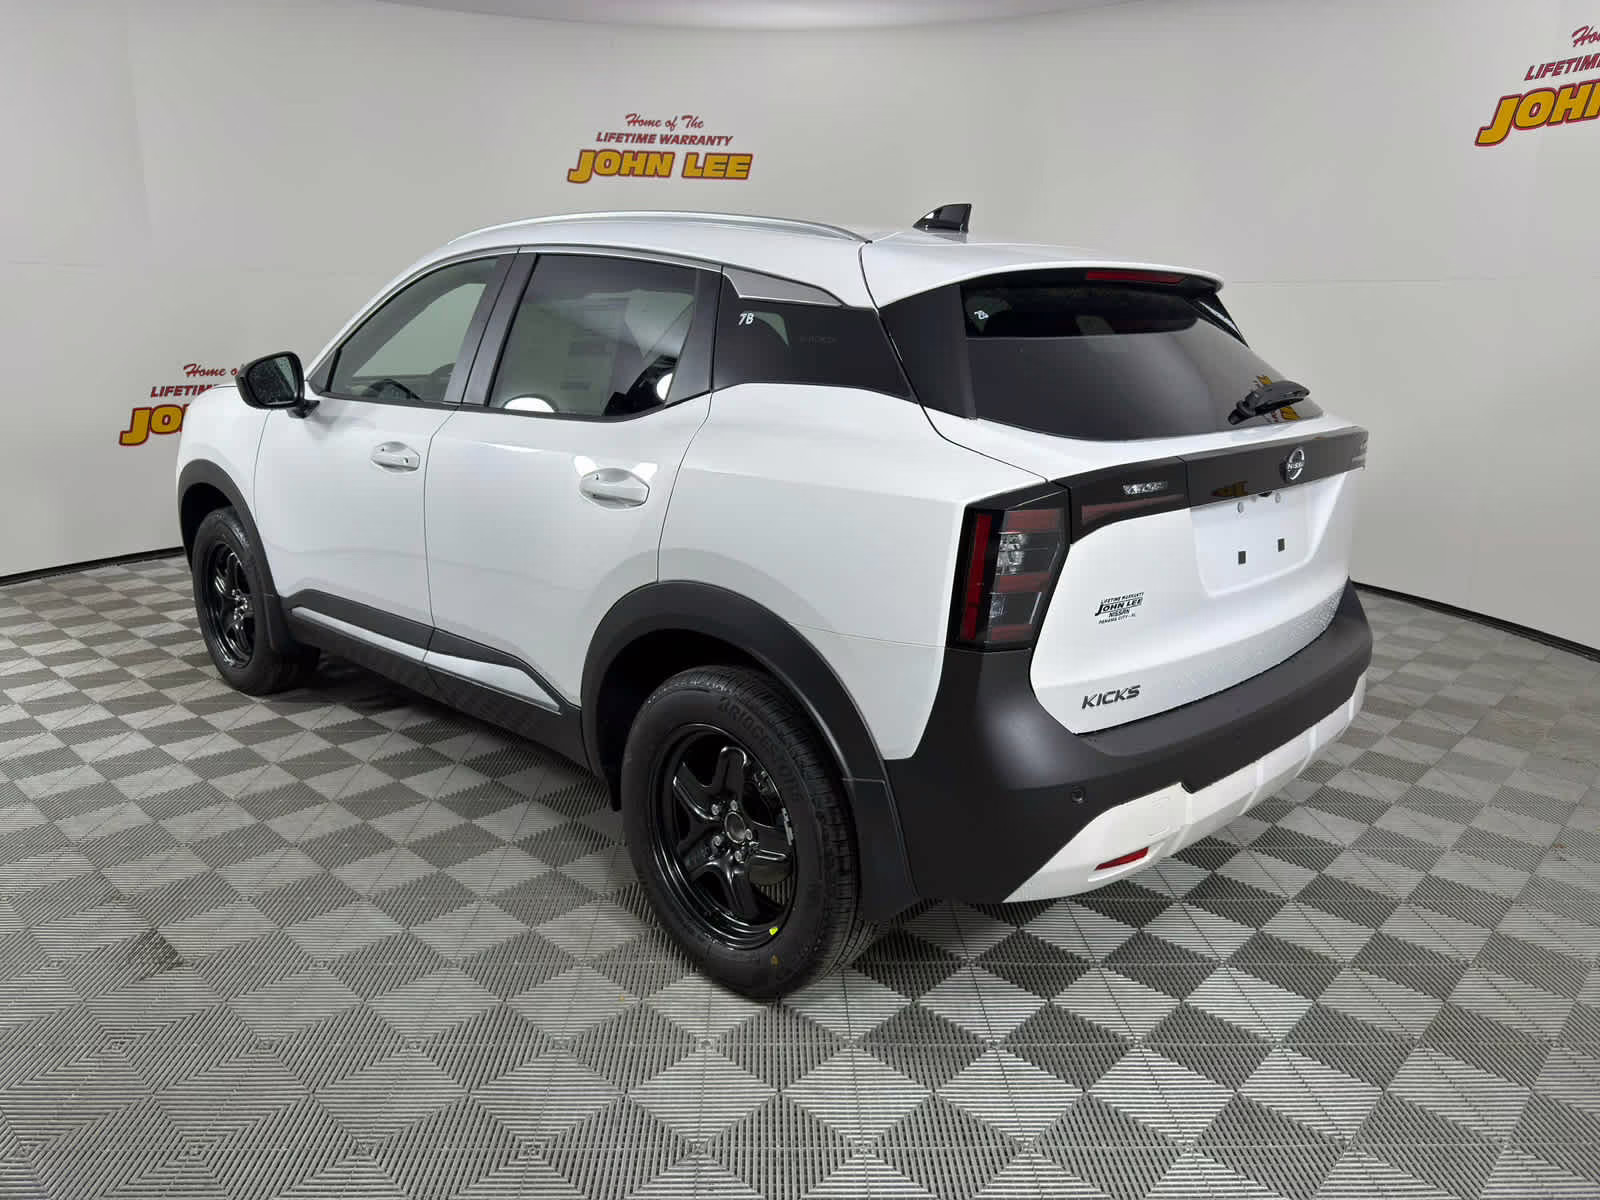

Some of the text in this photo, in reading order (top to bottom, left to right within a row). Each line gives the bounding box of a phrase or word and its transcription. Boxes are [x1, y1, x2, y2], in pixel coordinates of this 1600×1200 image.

[625, 113, 704, 132] Home of The
[596, 132, 734, 147] LIFETIME WARRANTY
[567, 149, 753, 184] JOHN LEE
[183, 363, 240, 378] Home o
[119, 404, 190, 446] JO
[1094, 601, 1125, 617] JOHN
[1082, 685, 1141, 709] KICKS
